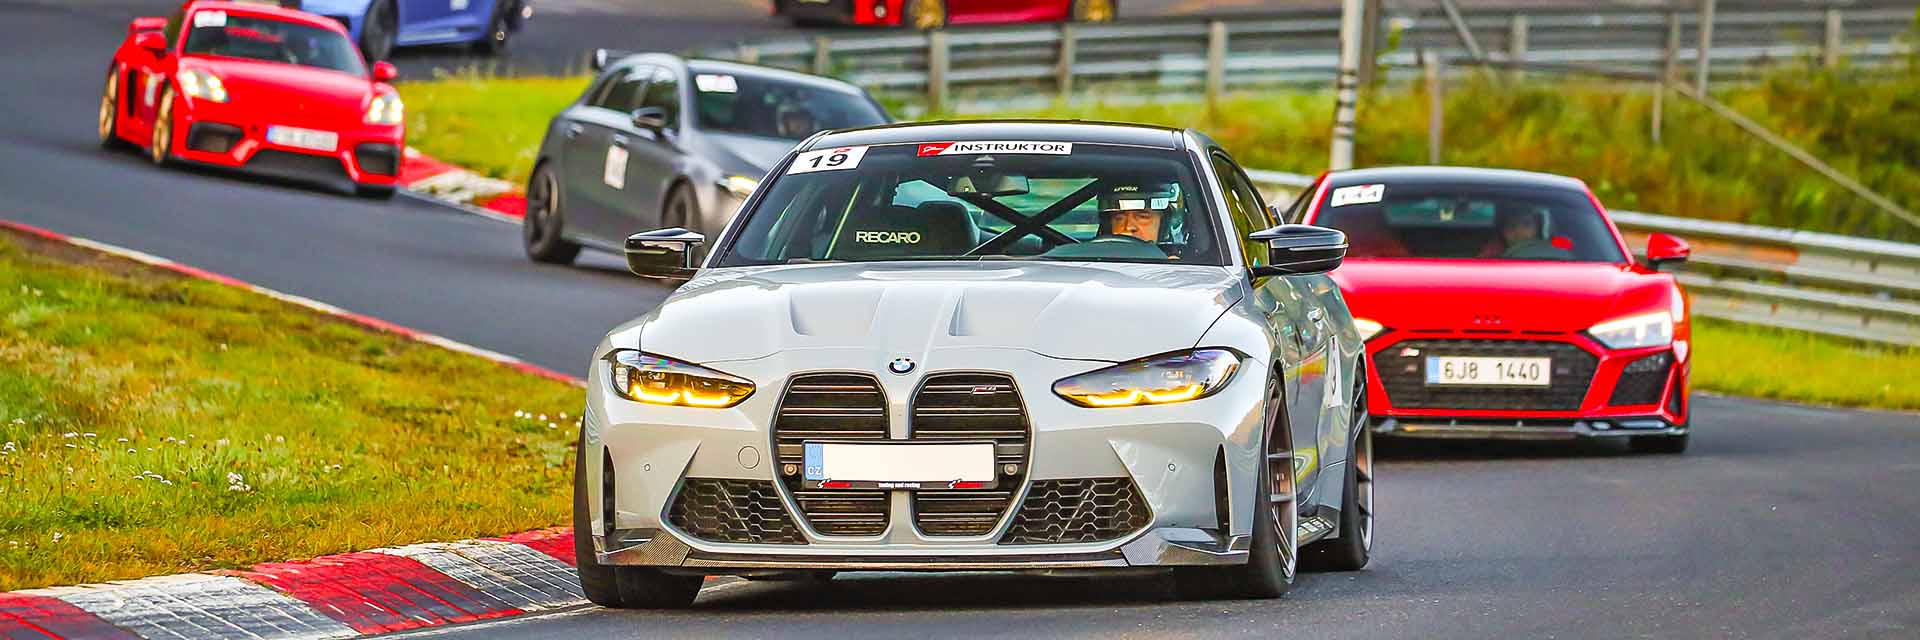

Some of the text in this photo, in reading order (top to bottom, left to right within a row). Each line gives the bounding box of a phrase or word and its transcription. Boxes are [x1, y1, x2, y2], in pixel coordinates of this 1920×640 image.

[954, 143, 1065, 152] INSTRUKTOR
[809, 154, 848, 168] 19
[855, 231, 921, 244] RECARO
[1444, 362, 1540, 381] 6J8 1440
[807, 466, 821, 475] CZ
